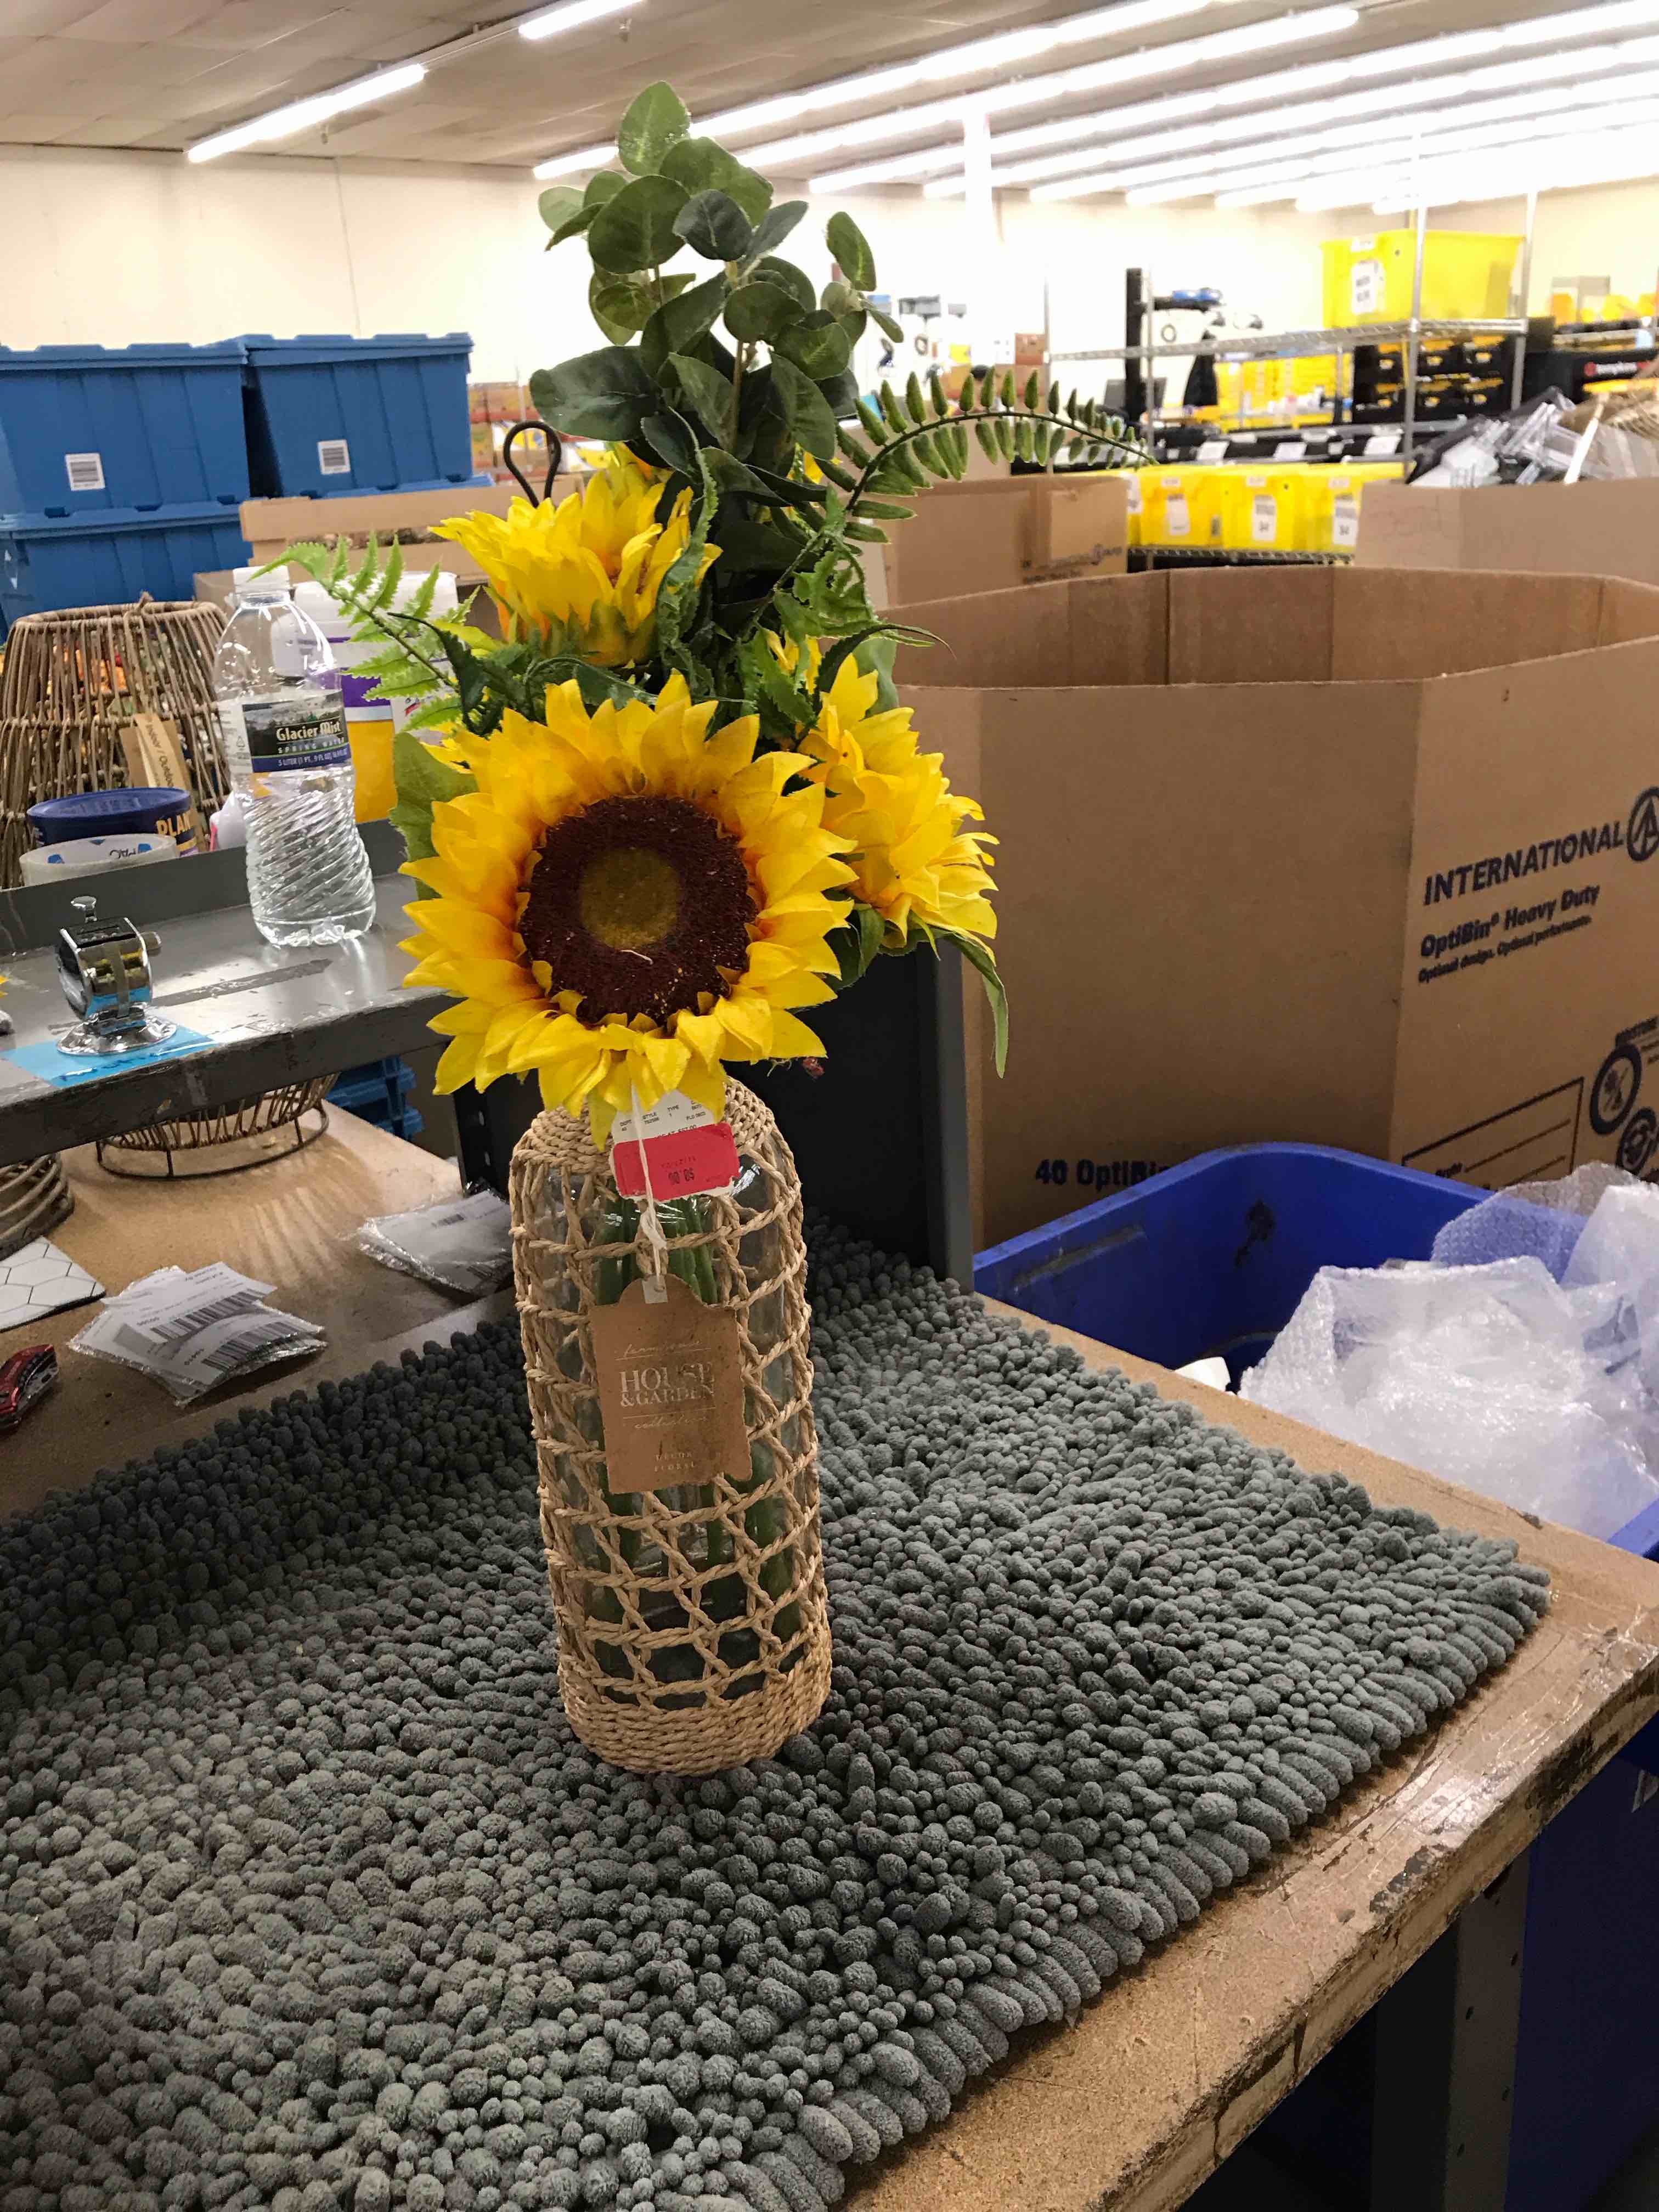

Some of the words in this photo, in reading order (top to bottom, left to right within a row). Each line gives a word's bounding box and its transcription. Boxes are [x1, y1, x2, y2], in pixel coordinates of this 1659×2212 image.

[276, 726, 318, 741] Glacier
[320, 721, 341, 735] Mist
[278, 744, 317, 754] SPRING
[1423, 821, 1624, 906] INTERNATIONAL
[1504, 899, 1556, 930] Heavy
[1560, 885, 1600, 911] Duty
[1035, 1159, 1068, 1186] 40
[619, 1362, 715, 1393] HOUSE
